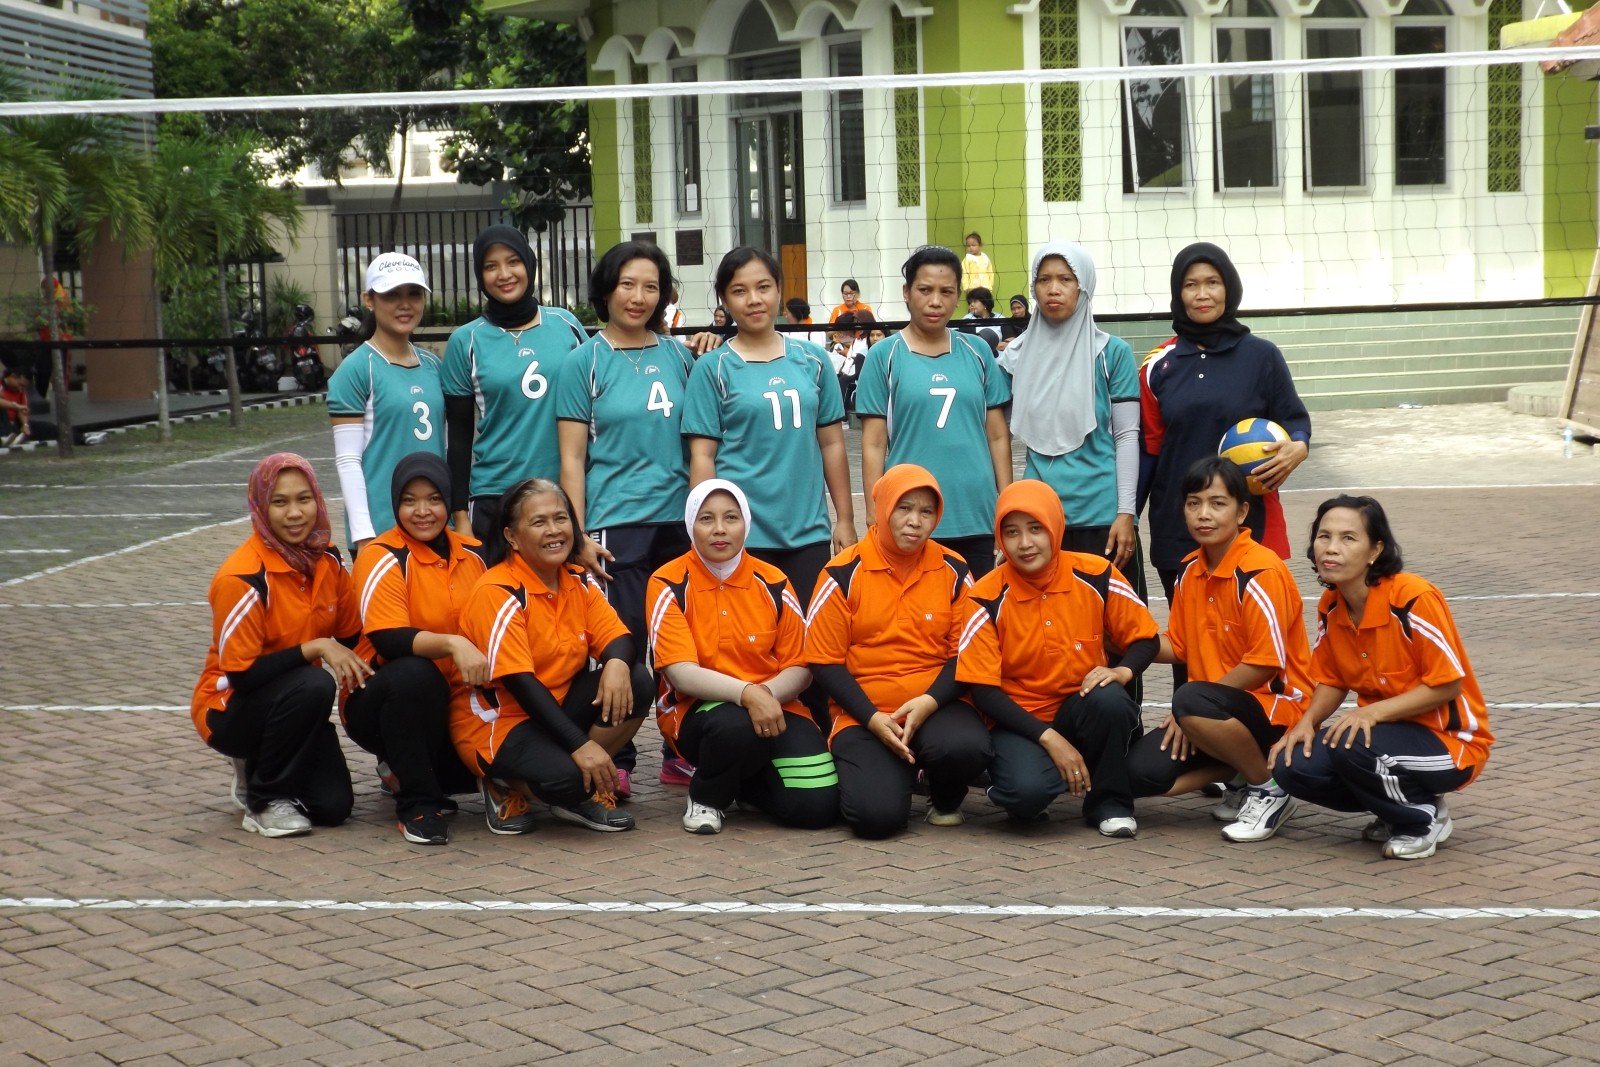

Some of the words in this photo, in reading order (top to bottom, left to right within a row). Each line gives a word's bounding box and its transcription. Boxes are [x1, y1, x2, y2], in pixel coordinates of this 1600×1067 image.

[379, 259, 420, 271] Cleveland
[521, 360, 548, 400] 6
[647, 380, 674, 418] 4
[412, 401, 433, 441] 3
[762, 389, 802, 431] 11
[929, 387, 957, 429] 7
